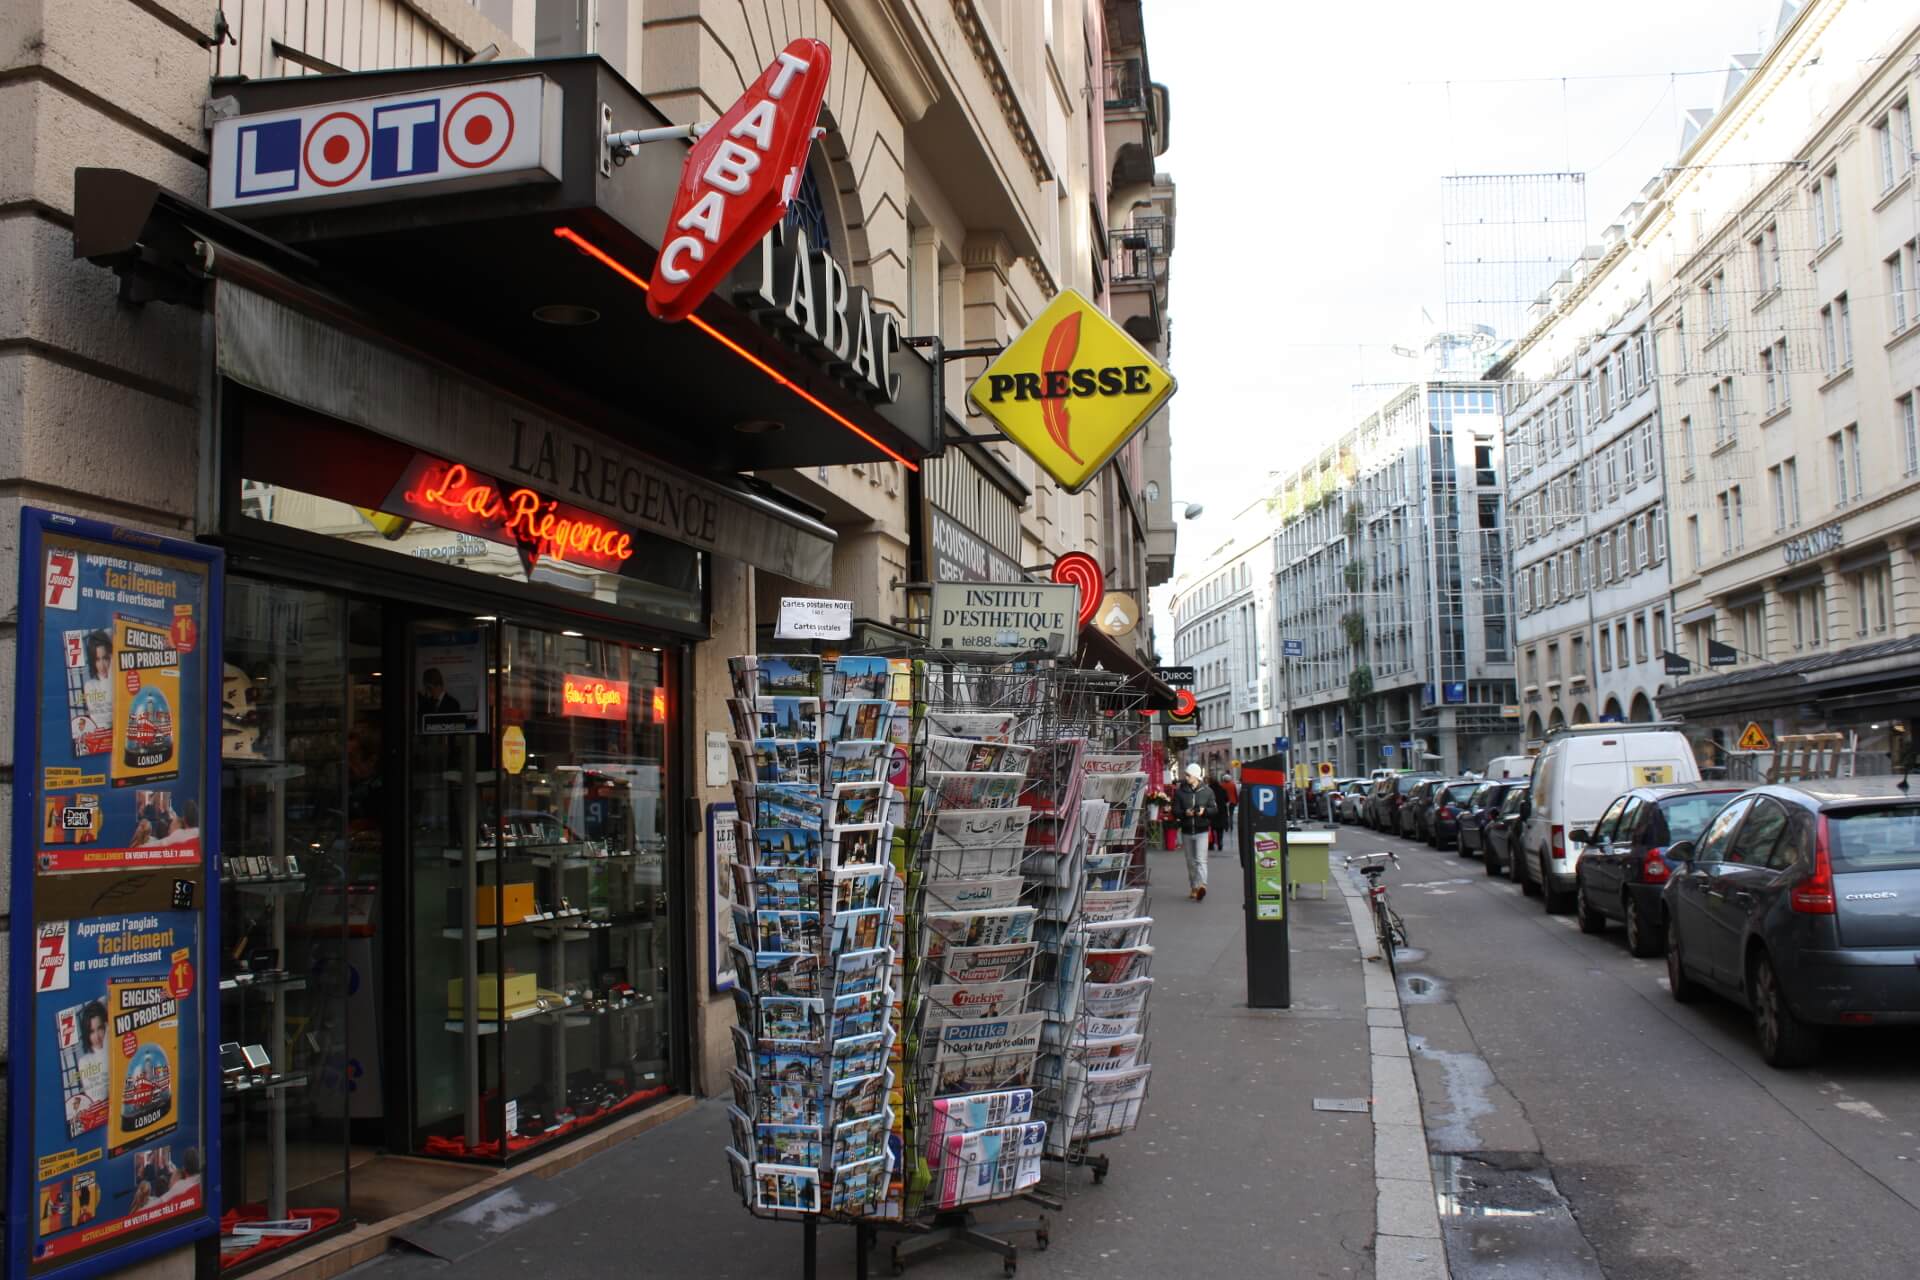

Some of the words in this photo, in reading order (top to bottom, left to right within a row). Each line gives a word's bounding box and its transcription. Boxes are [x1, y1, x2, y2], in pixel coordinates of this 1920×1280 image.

[236, 91, 515, 199] LOTO
[660, 52, 809, 284] TABAC
[988, 365, 1151, 403] PRESSE
[510, 418, 559, 486] LA
[570, 444, 719, 543] REGENCE
[426, 464, 501, 518] La
[506, 490, 633, 561] Régence
[933, 515, 986, 577] ACOUSTIQUE
[86, 553, 127, 570] Apprenez
[105, 569, 177, 599] facilement
[82, 587, 94, 597] en
[95, 590, 116, 601] vous
[116, 590, 165, 609] divertissant
[782, 600, 806, 608] Cartes
[806, 601, 833, 609] postales
[966, 590, 1044, 608] INSTITUT
[943, 609, 1065, 632] D'ESTHETIQUE
[127, 628, 164, 650] ENGLISH
[121, 653, 135, 669] NO
[137, 650, 177, 668] PROBLEM
[137, 753, 163, 766] LONDON
[1259, 788, 1274, 811] P
[77, 922, 120, 938] Apprenez
[122, 916, 159, 933] l'anglais
[98, 928, 175, 954] facilement
[74, 961, 85, 972] en
[88, 957, 109, 970] vous
[110, 950, 162, 967] divertissant
[122, 988, 162, 1008] ENGLISH
[116, 1016, 131, 1034] NO
[133, 1000, 176, 1027] PROBLEM
[948, 1023, 1007, 1040] Politika
[135, 1110, 161, 1129] LONDON
